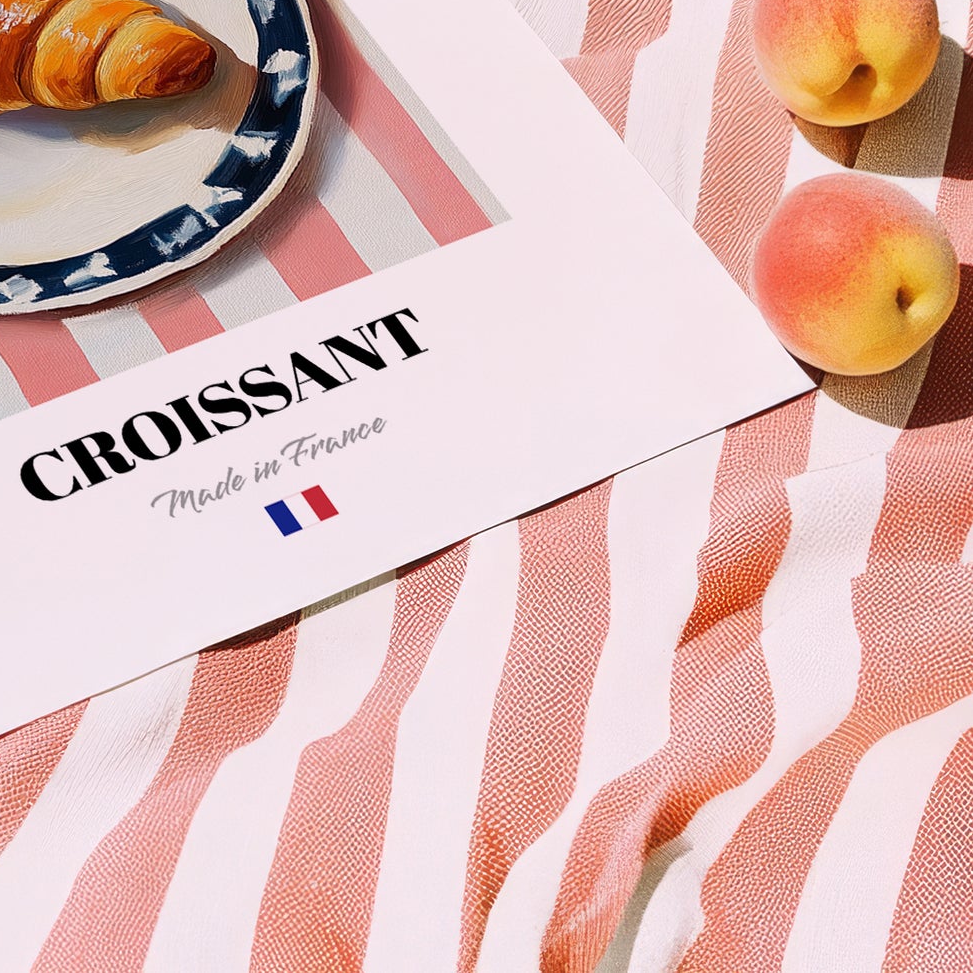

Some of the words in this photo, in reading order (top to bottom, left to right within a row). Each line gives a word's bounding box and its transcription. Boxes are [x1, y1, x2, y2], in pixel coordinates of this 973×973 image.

[20, 308, 429, 502] CROISSANT
[150, 467, 247, 518] Made
[254, 459, 282, 483] in
[280, 416, 388, 467] France
